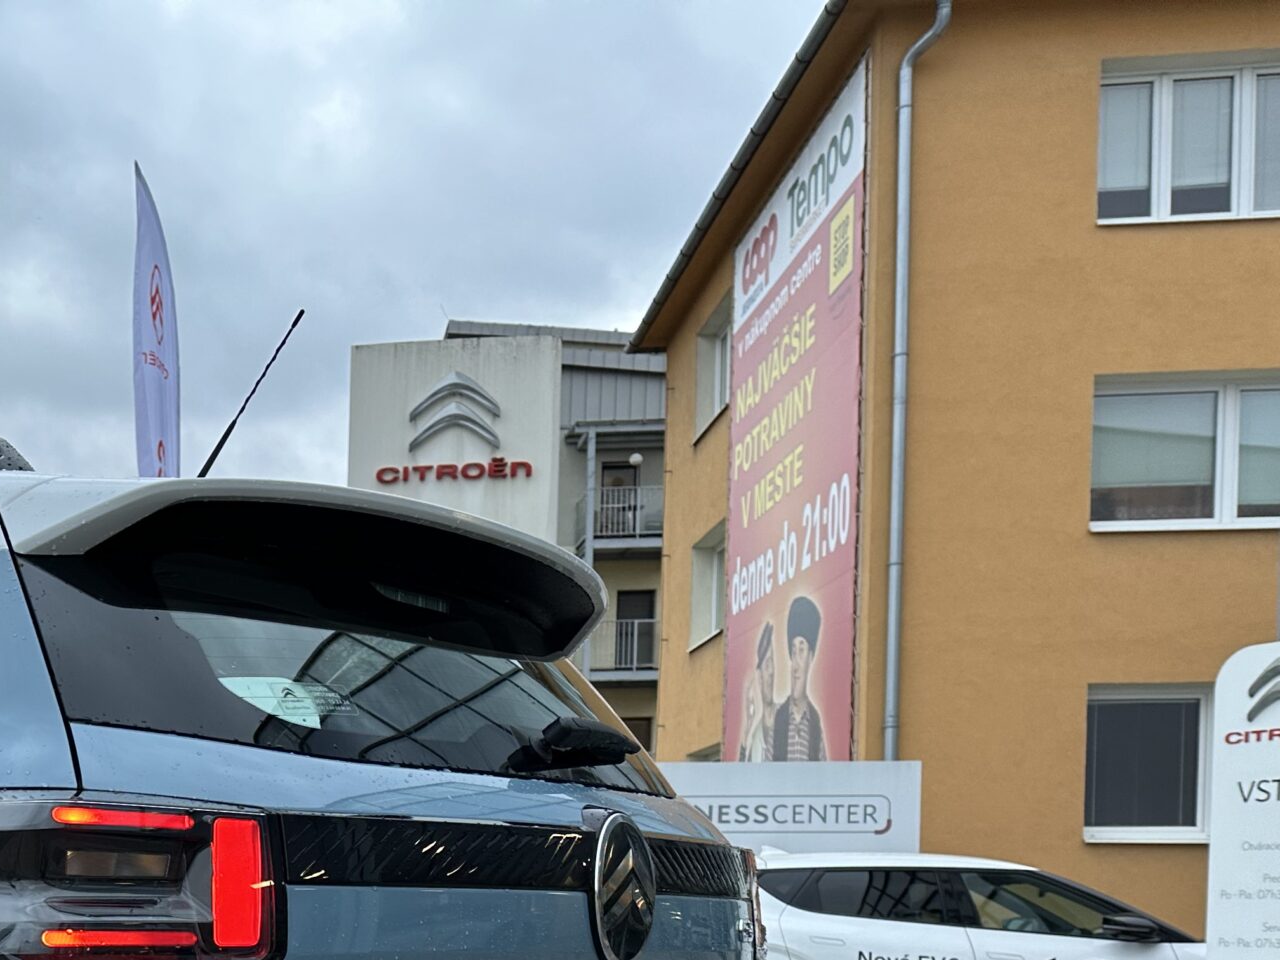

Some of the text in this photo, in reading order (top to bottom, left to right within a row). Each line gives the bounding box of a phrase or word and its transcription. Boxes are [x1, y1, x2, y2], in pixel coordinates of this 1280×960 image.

[787, 114, 853, 238] Tempo
[734, 367, 816, 481] POTRAVINY
[732, 473, 850, 616] denne do 21:00
[741, 444, 804, 528] V MESTE
